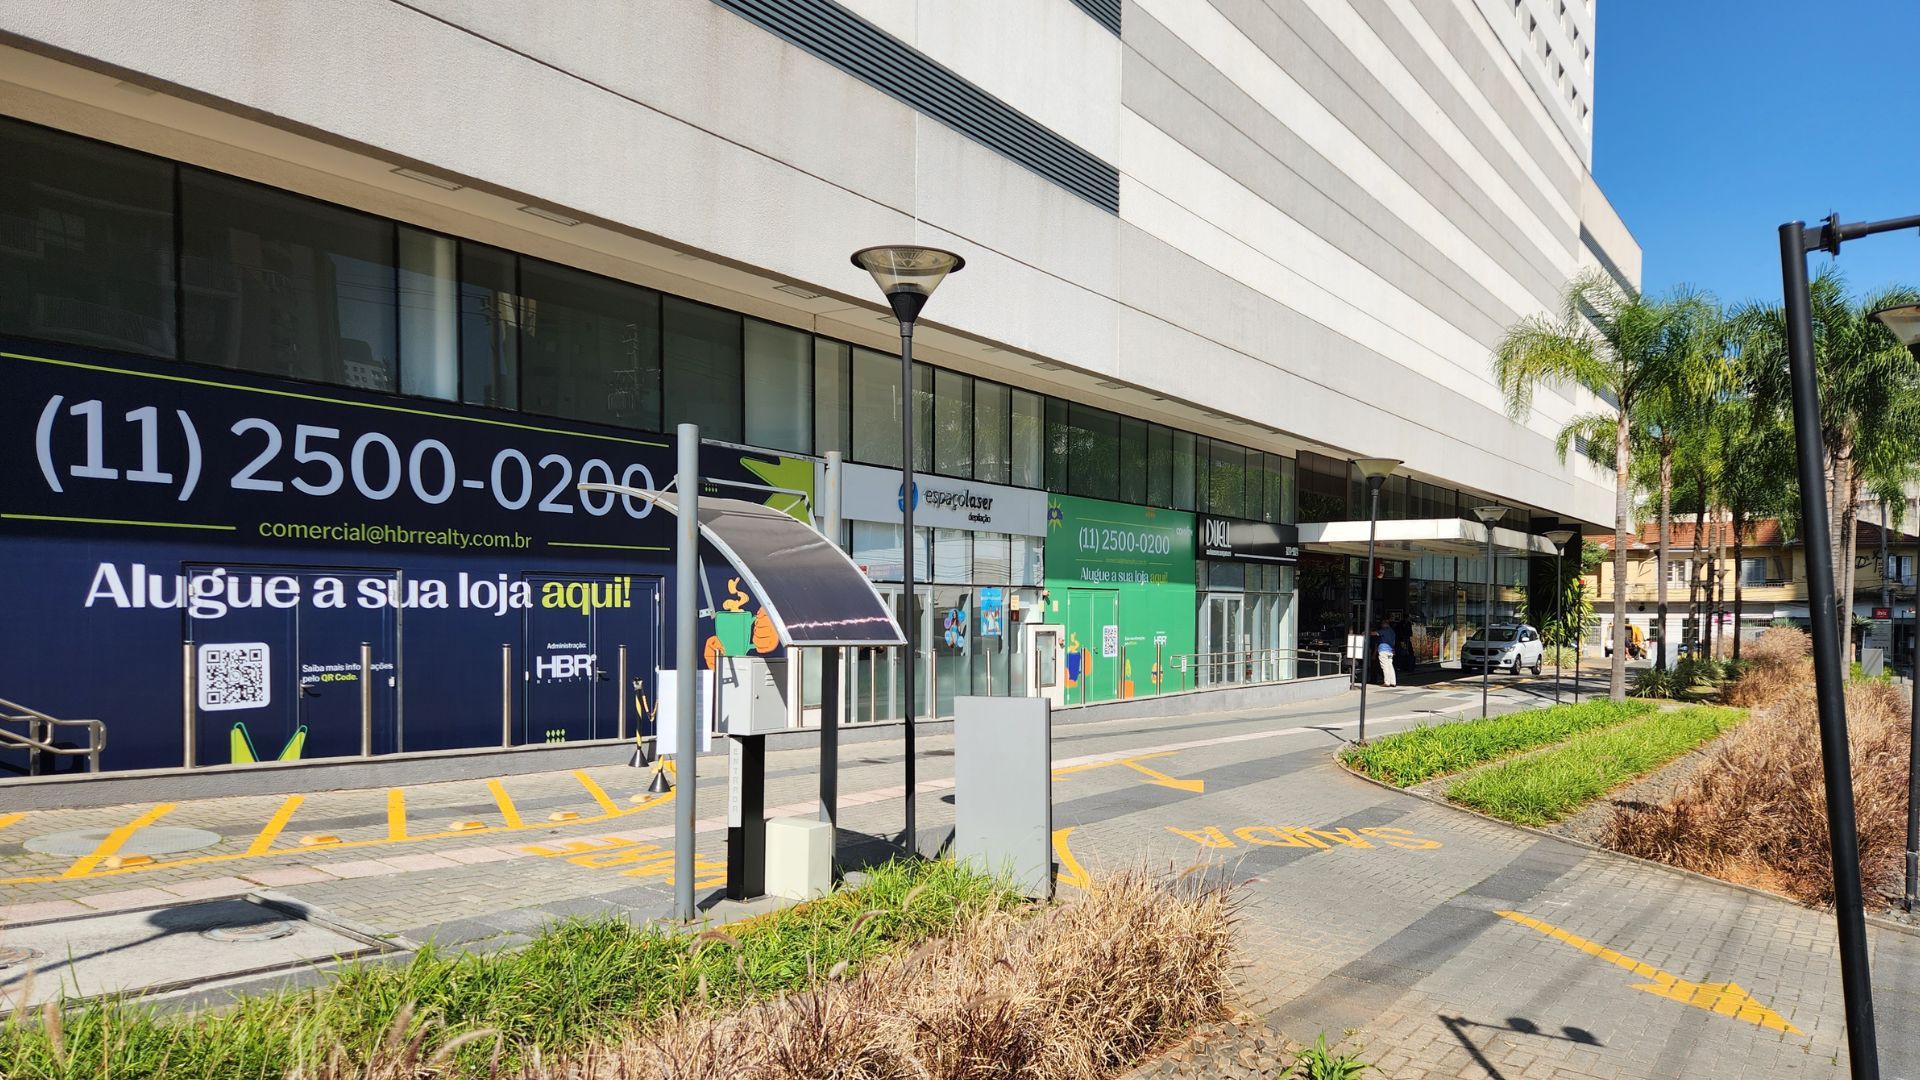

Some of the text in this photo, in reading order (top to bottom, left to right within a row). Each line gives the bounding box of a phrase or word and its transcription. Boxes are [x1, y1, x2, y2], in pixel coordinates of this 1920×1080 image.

[36, 395, 655, 519] (11) 2500-0200
[926, 489, 993, 511] espaçolaser
[259, 522, 532, 549] comercial@hbrrealty.com.br
[1079, 527, 1170, 555] (11) 2500-0200
[1081, 567, 1110, 584] Alugue
[1111, 574, 1117, 582] a
[1118, 573, 1133, 582] sua
[1135, 571, 1149, 585] loja
[84, 562, 631, 619] Alugue a sua loja aqui!
[302, 662, 394, 673] Saiba mais infoações
[302, 673, 358, 683] pelo QR Code.
[536, 654, 593, 679] HBR
